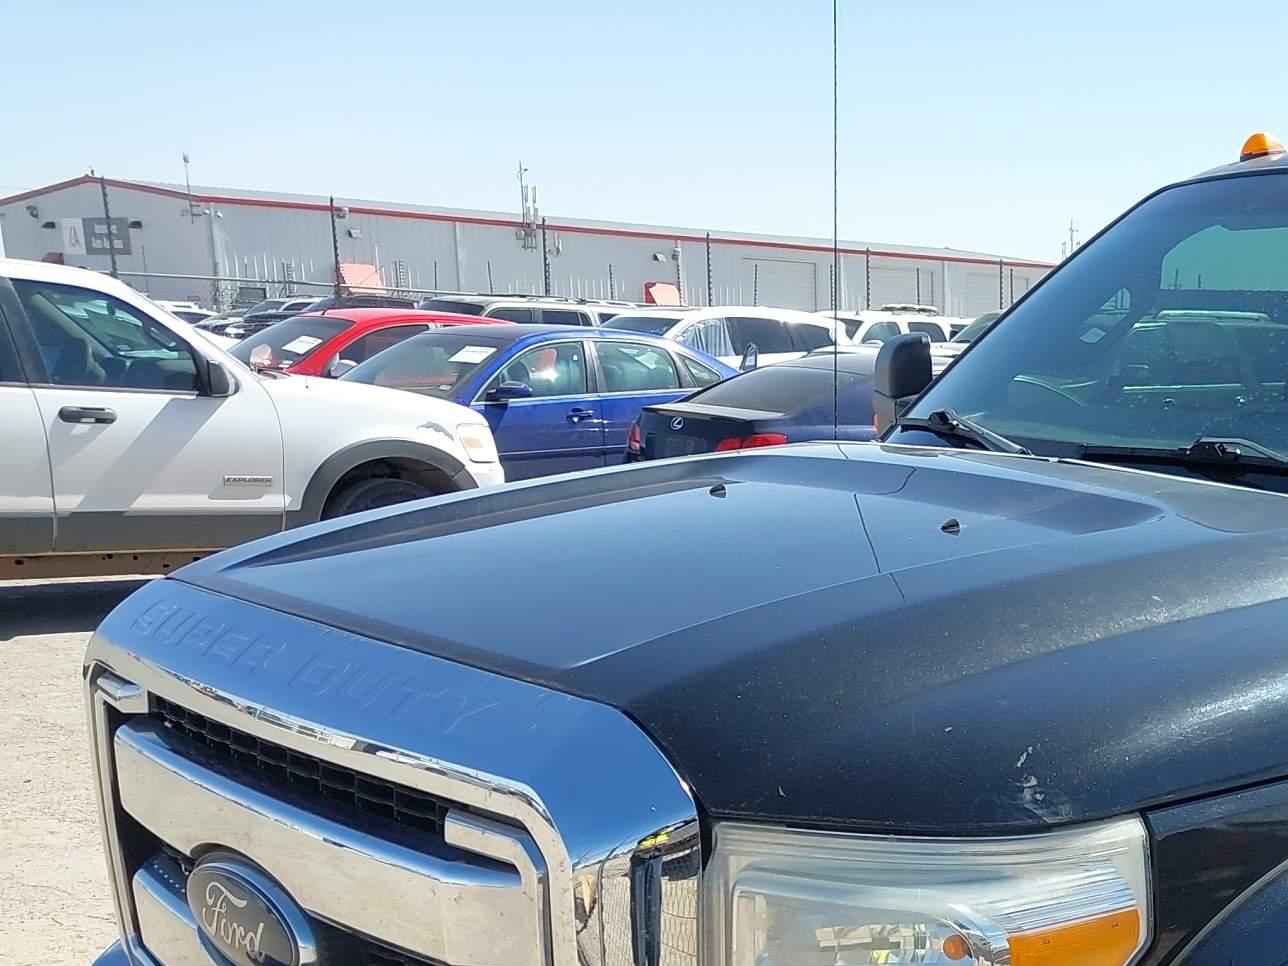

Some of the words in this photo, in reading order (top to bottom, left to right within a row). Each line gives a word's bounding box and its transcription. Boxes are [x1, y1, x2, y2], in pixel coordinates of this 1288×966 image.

[131, 599, 286, 675] SUPER
[288, 651, 499, 735] DUTY
[202, 881, 265, 961] Ford
